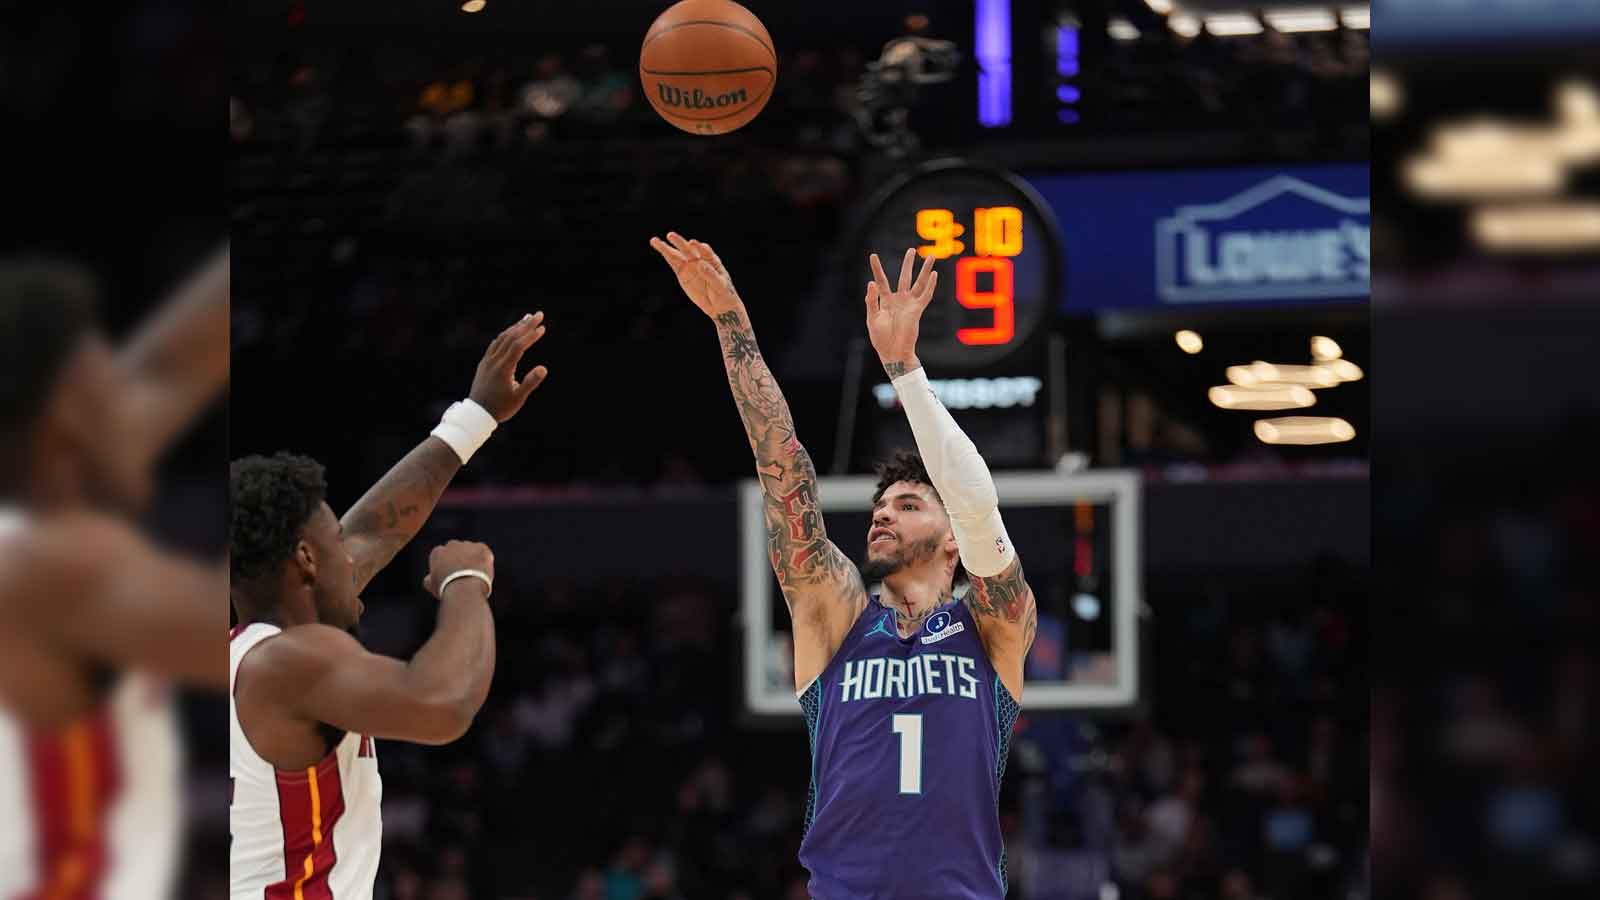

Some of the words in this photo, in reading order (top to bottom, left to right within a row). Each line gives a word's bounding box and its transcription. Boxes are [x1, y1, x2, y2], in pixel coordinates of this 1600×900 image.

[657, 81, 748, 109] Wilson
[916, 207, 1023, 259] 9:10
[956, 257, 1014, 345] 9
[838, 653, 981, 702] HORNETS
[892, 713, 922, 794] 1
